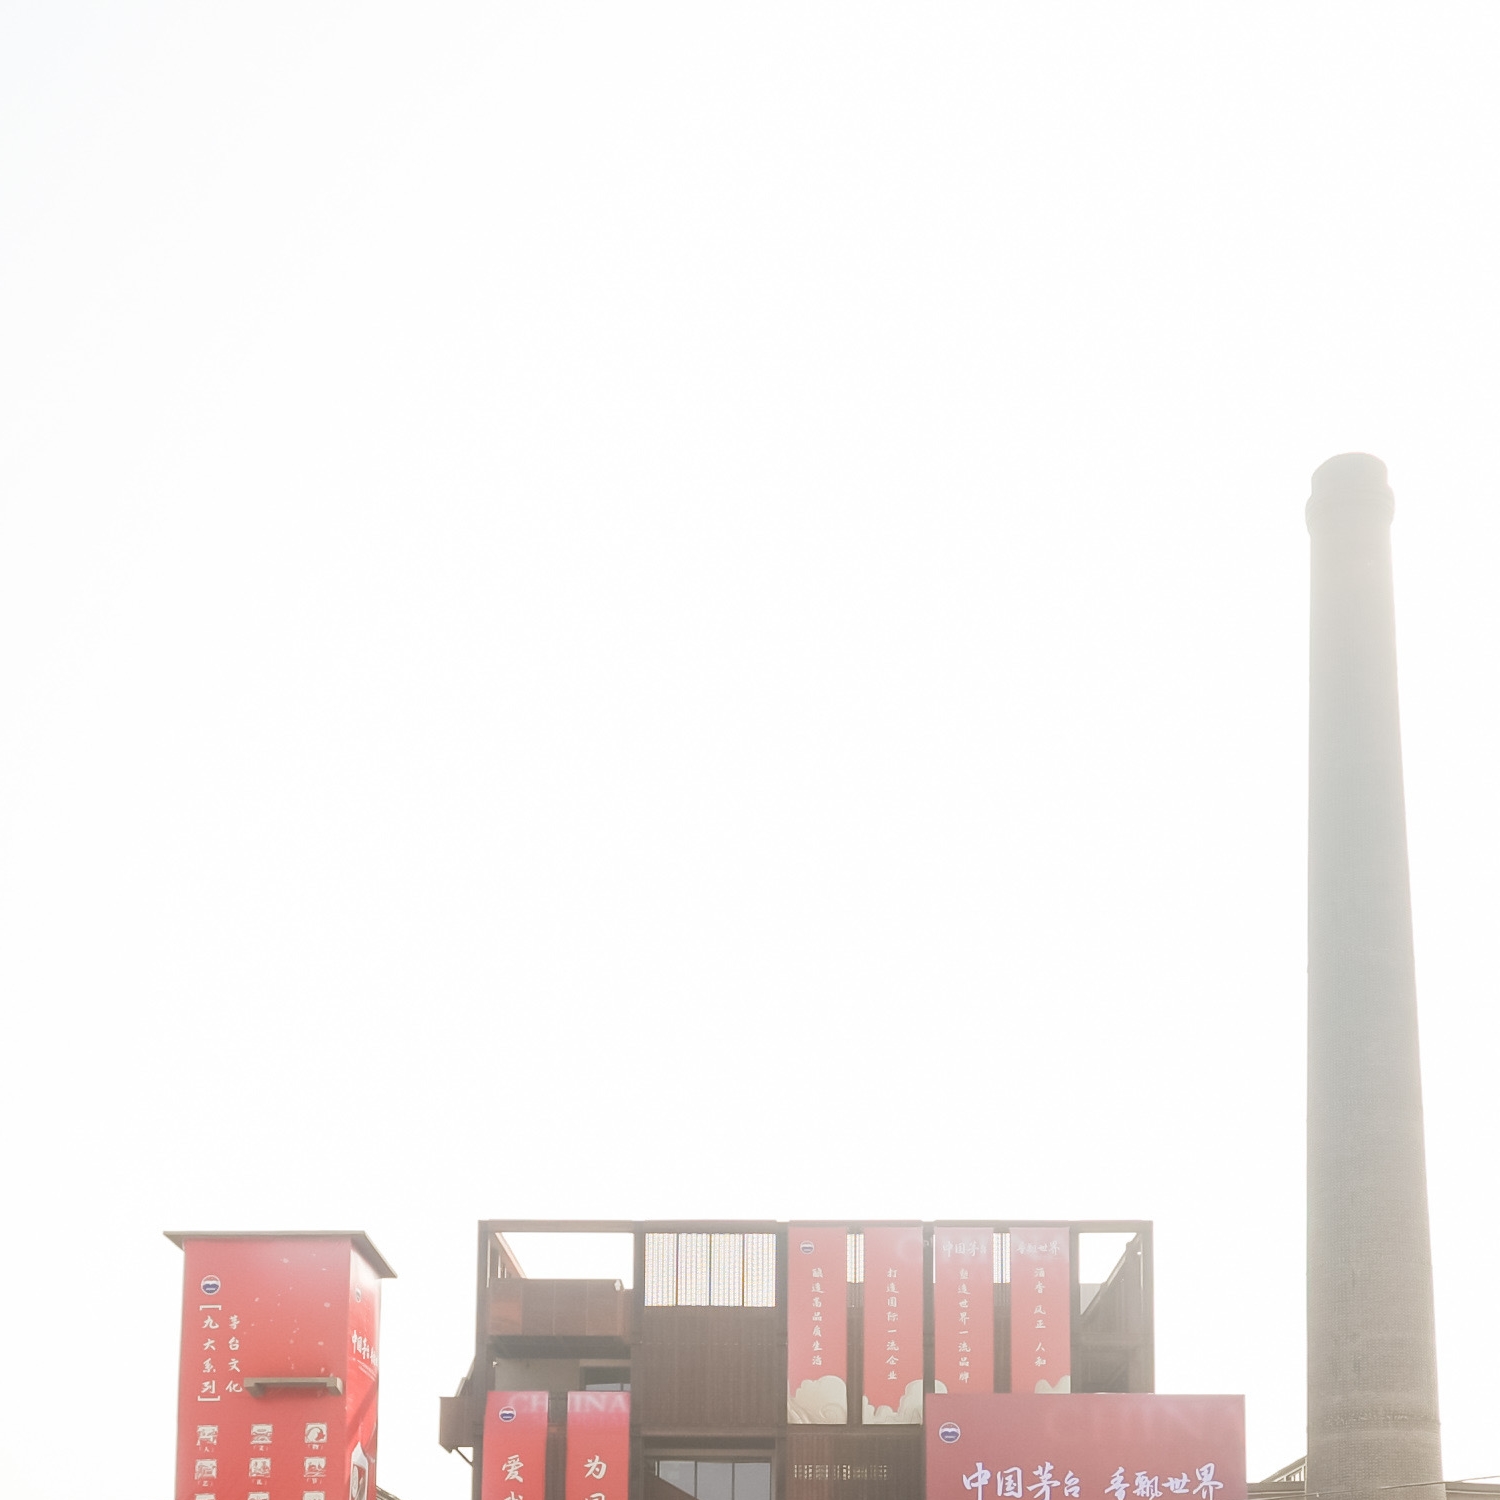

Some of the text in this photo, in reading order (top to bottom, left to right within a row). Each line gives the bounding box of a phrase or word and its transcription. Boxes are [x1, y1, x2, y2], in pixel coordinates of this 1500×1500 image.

[225, 1314, 243, 1394] 茅台文化
[811, 1267, 824, 1367] 酿造高品质生活
[885, 1267, 899, 1381] 打造国际一流企业
[957, 1267, 971, 1384] 塑造世界一流品牌
